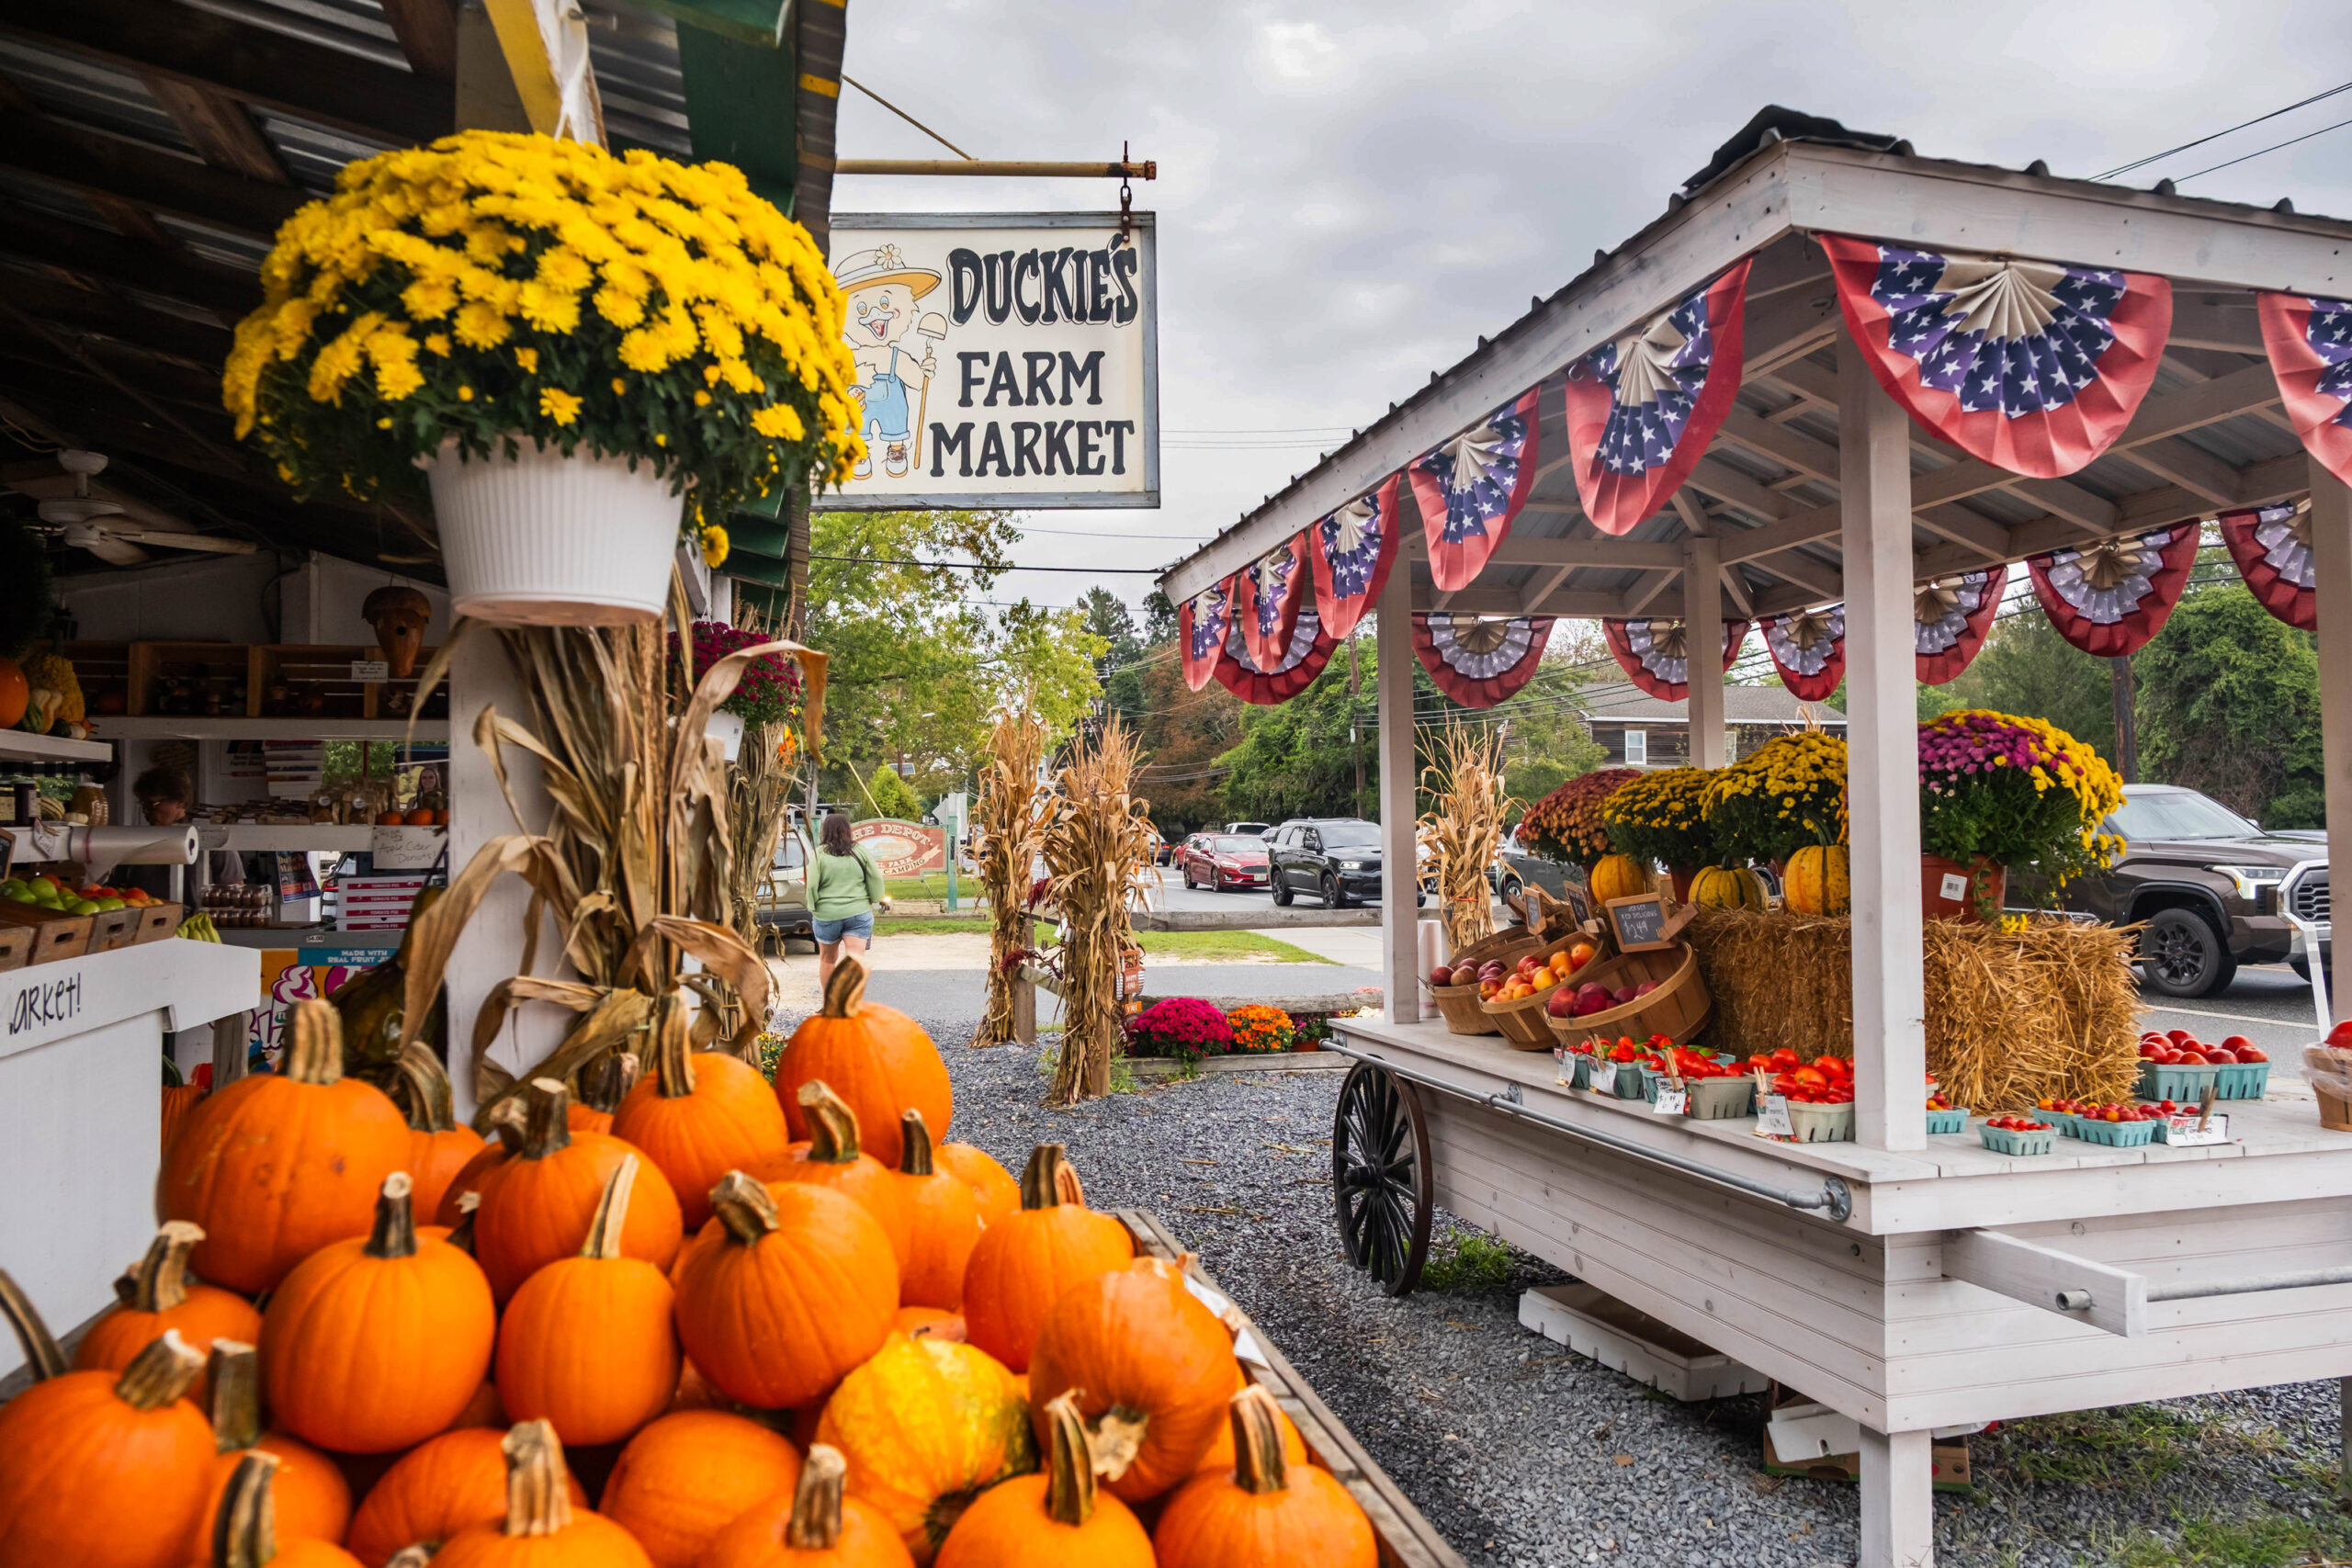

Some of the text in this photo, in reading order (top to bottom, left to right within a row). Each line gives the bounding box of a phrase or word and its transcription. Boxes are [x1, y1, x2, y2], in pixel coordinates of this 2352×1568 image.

[948, 233, 1138, 328] DUCKIE'S
[956, 351, 1105, 407] FARM
[929, 420, 1136, 477] MARKET
[853, 825, 876, 840] HE
[883, 858, 925, 875] CAMPING
[888, 857, 913, 868] PARK
